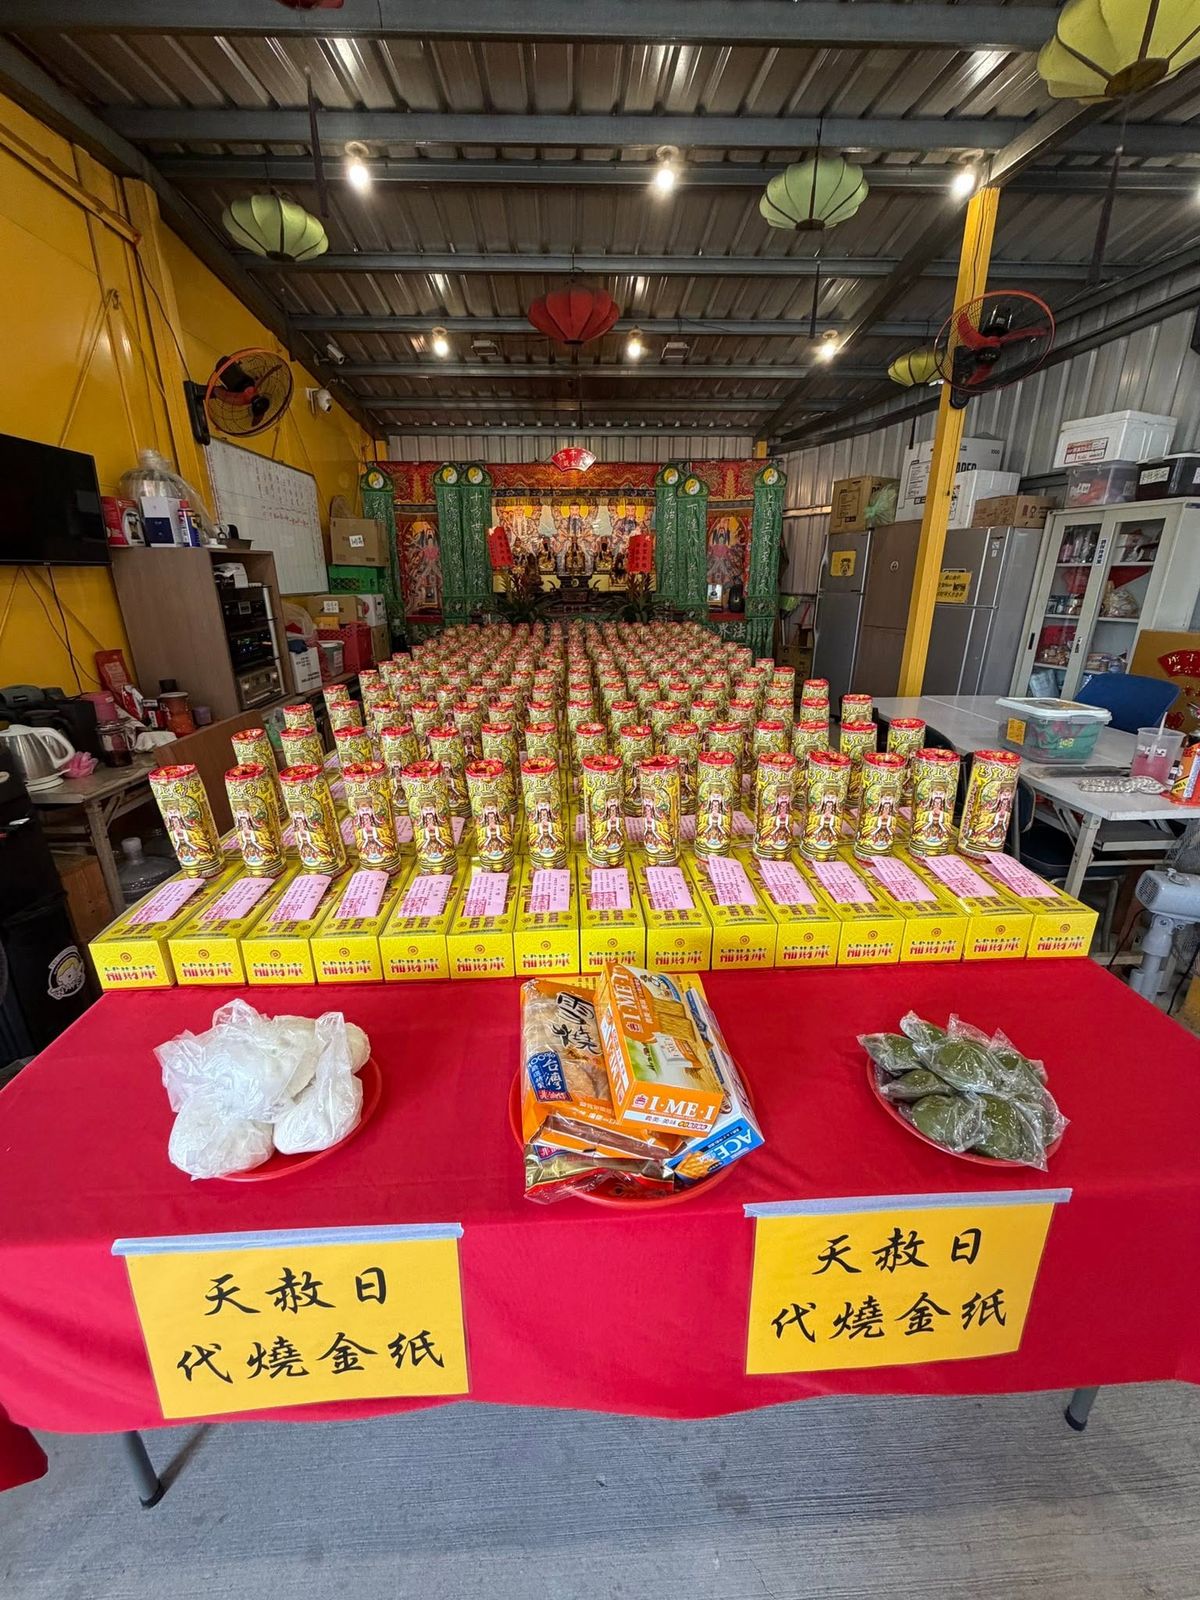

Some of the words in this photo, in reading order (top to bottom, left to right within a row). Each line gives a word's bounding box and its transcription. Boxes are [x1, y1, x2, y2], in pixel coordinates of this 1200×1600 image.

[527, 1051, 556, 1069] 100%
[713, 1128, 753, 1160] ACE
[812, 1227, 982, 1275] 天赦日
[204, 1266, 387, 1316] 天赦日
[771, 1288, 1007, 1343] 代燒金紙
[176, 1329, 445, 1385] 代燒金紙
